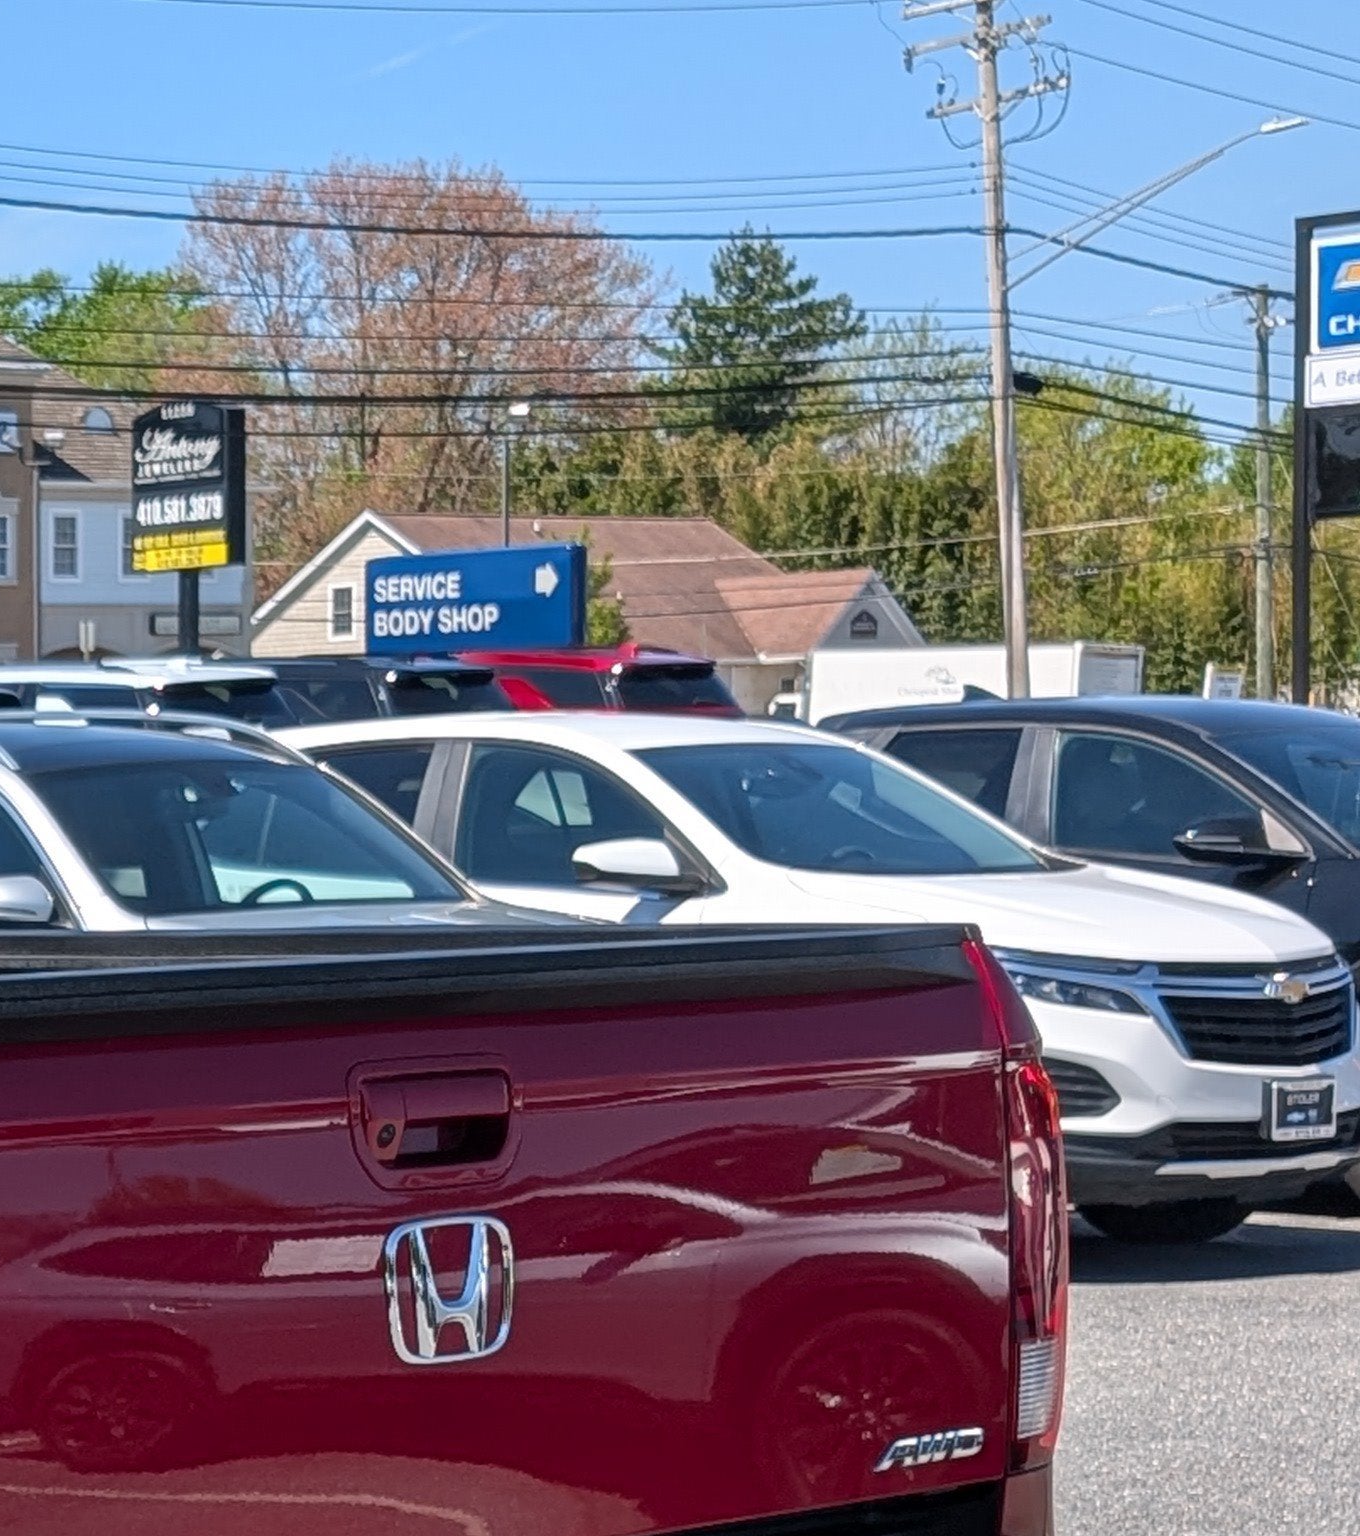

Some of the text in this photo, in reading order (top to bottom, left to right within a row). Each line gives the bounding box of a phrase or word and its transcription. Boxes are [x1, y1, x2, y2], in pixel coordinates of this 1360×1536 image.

[137, 458, 204, 478] JEWELERS
[373, 571, 461, 603] SERVICE
[373, 603, 500, 637] BODY SHOP
[873, 1426, 983, 1472] AWD
